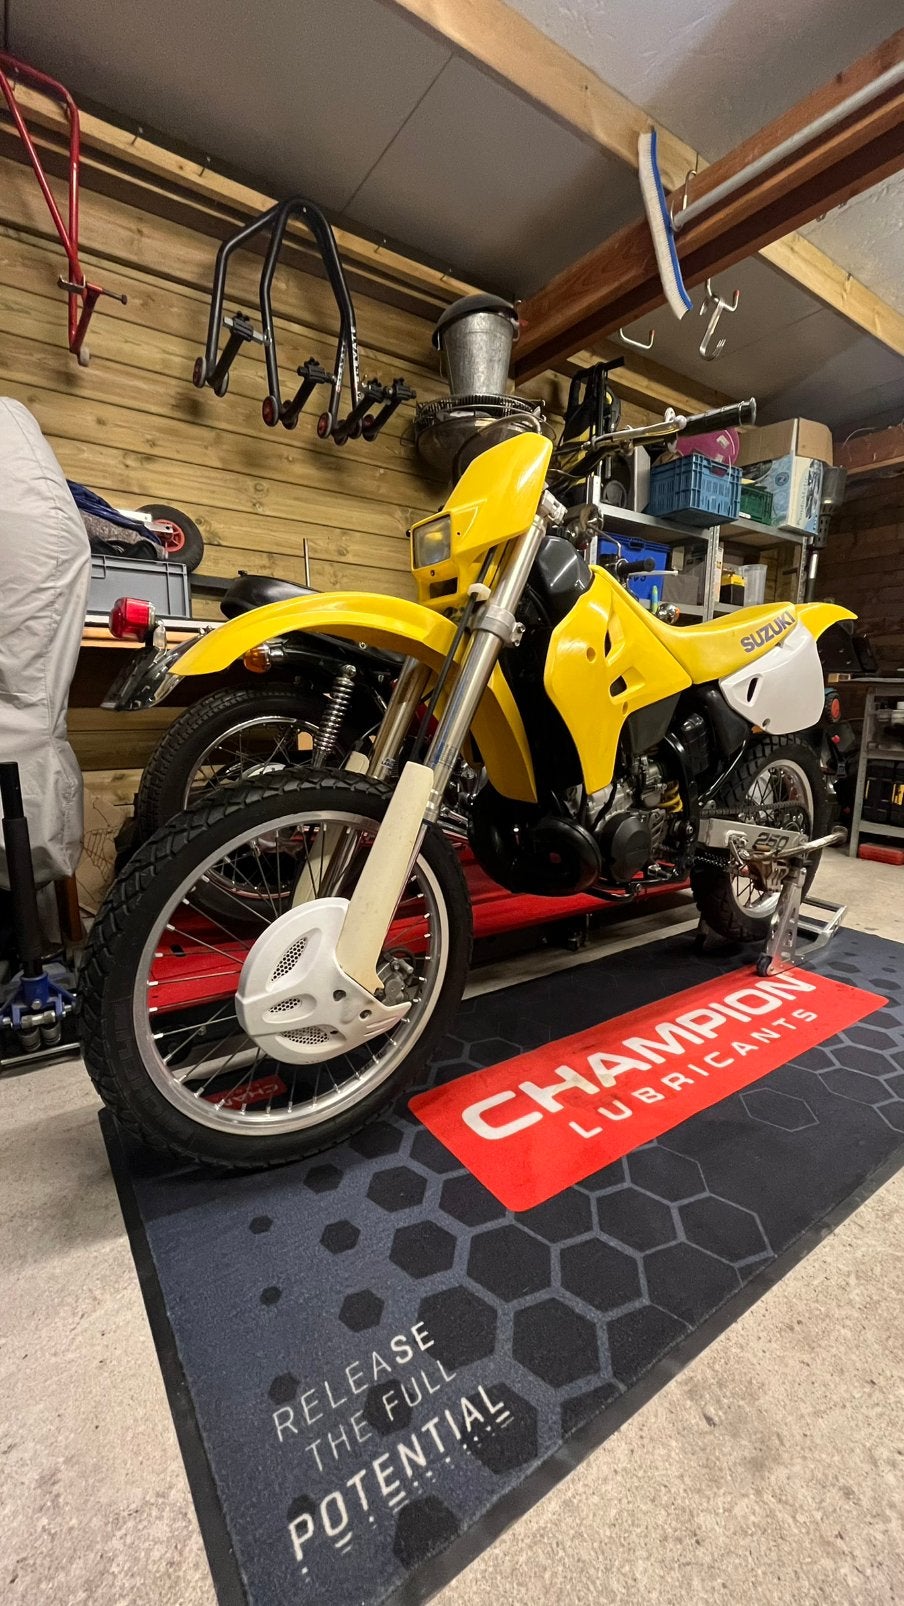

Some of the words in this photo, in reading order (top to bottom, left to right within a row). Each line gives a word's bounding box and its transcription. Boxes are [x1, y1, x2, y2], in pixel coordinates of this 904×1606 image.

[740, 610, 796, 653] SUZUKI
[752, 831, 790, 856] 250
[461, 972, 817, 1141] CHAMPION
[568, 1008, 818, 1139] LUBRICANTS
[272, 1321, 435, 1442] RELEASE
[304, 1409, 373, 1472] THE
[381, 1359, 457, 1422] FULL
[288, 1384, 505, 1562] POTENTIAL
